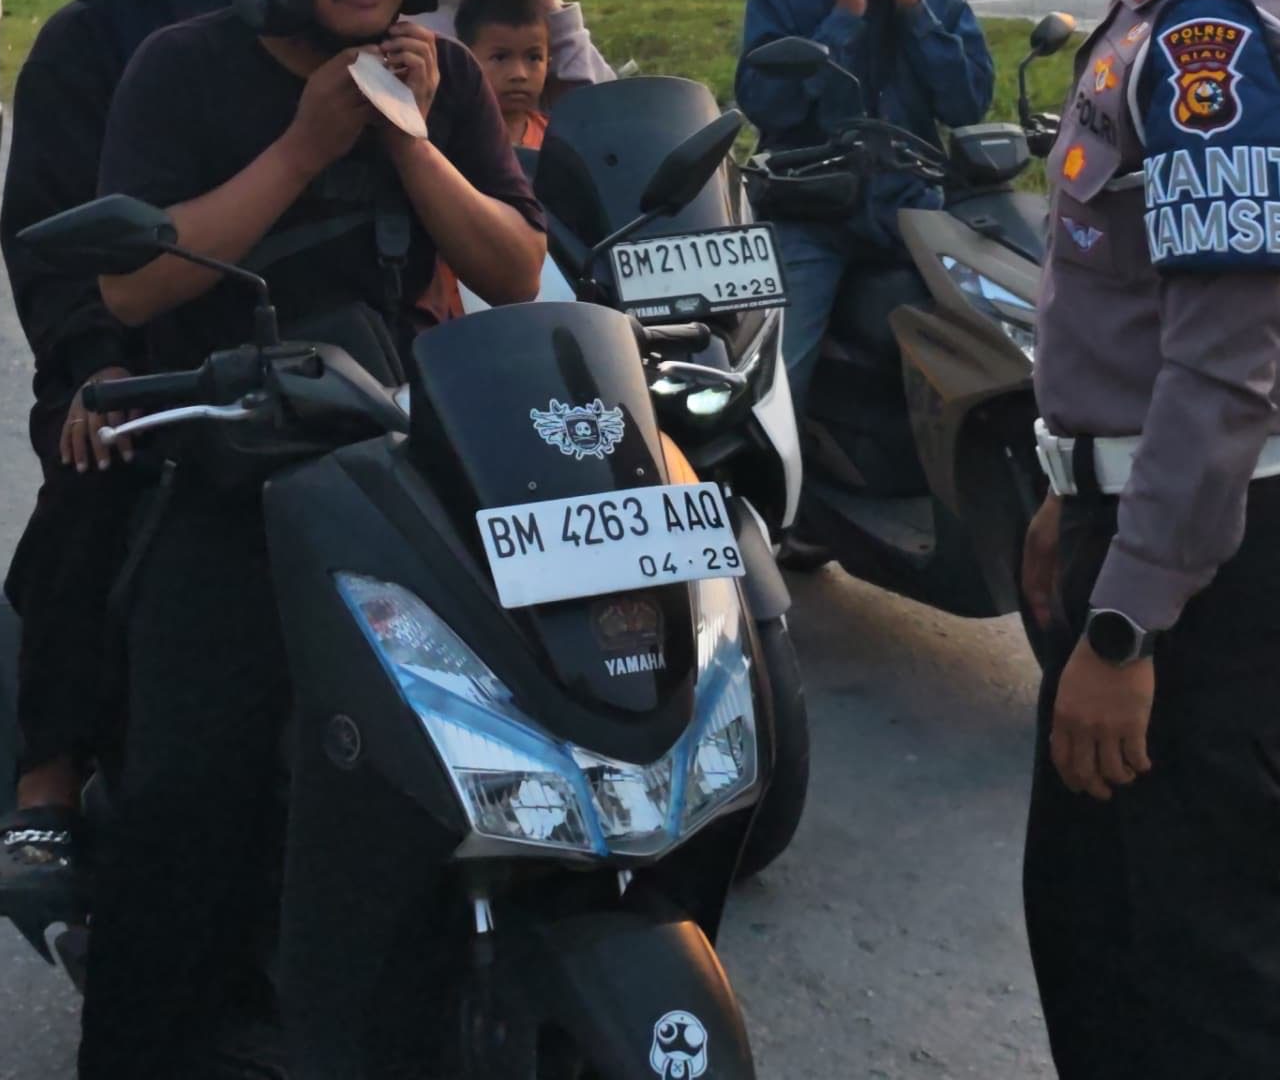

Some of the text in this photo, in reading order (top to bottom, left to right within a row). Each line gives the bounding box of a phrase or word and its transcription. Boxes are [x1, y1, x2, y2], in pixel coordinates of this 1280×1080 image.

[1170, 24, 1237, 44] POLRES
[1180, 50, 1227, 62] RIAU
[487, 489, 726, 559] BM 4263 AAQ
[603, 652, 666, 677] YAMAHA
